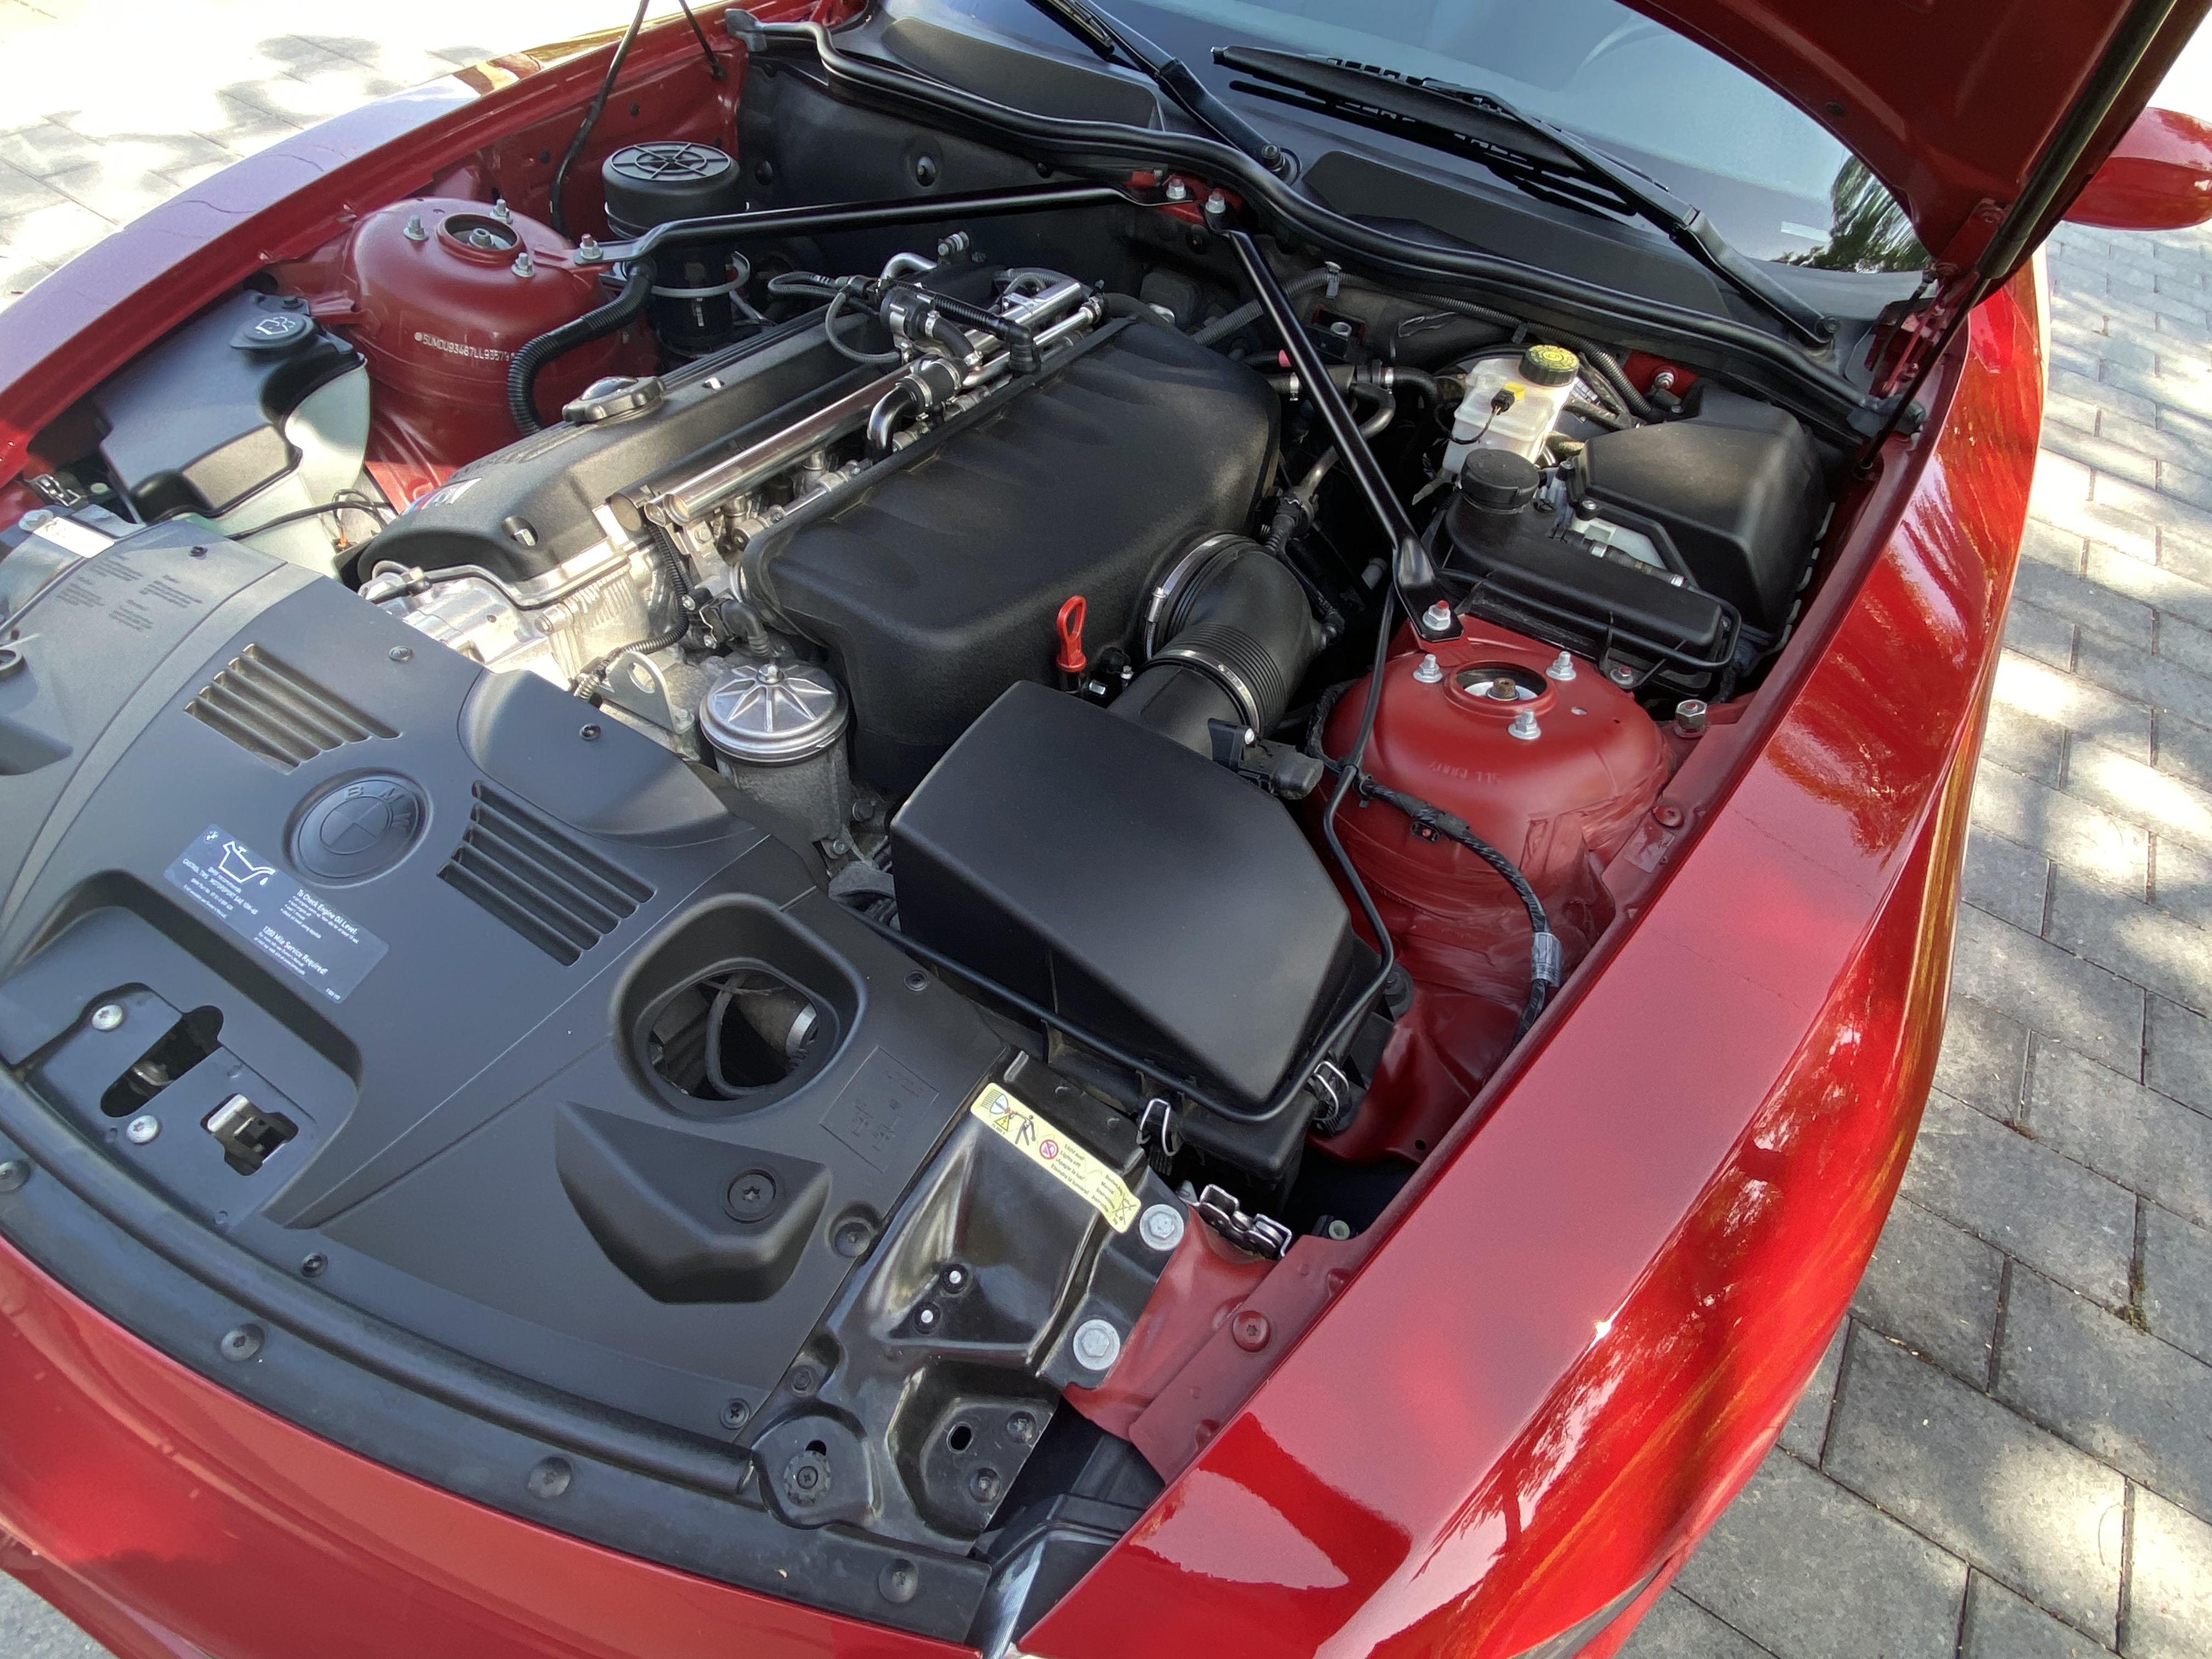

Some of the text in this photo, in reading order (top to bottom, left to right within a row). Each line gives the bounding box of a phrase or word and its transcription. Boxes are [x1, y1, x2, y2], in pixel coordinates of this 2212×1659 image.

[317, 904, 336, 919] Engine
[273, 933, 285, 945] Mile
[284, 941, 303, 958] Service
